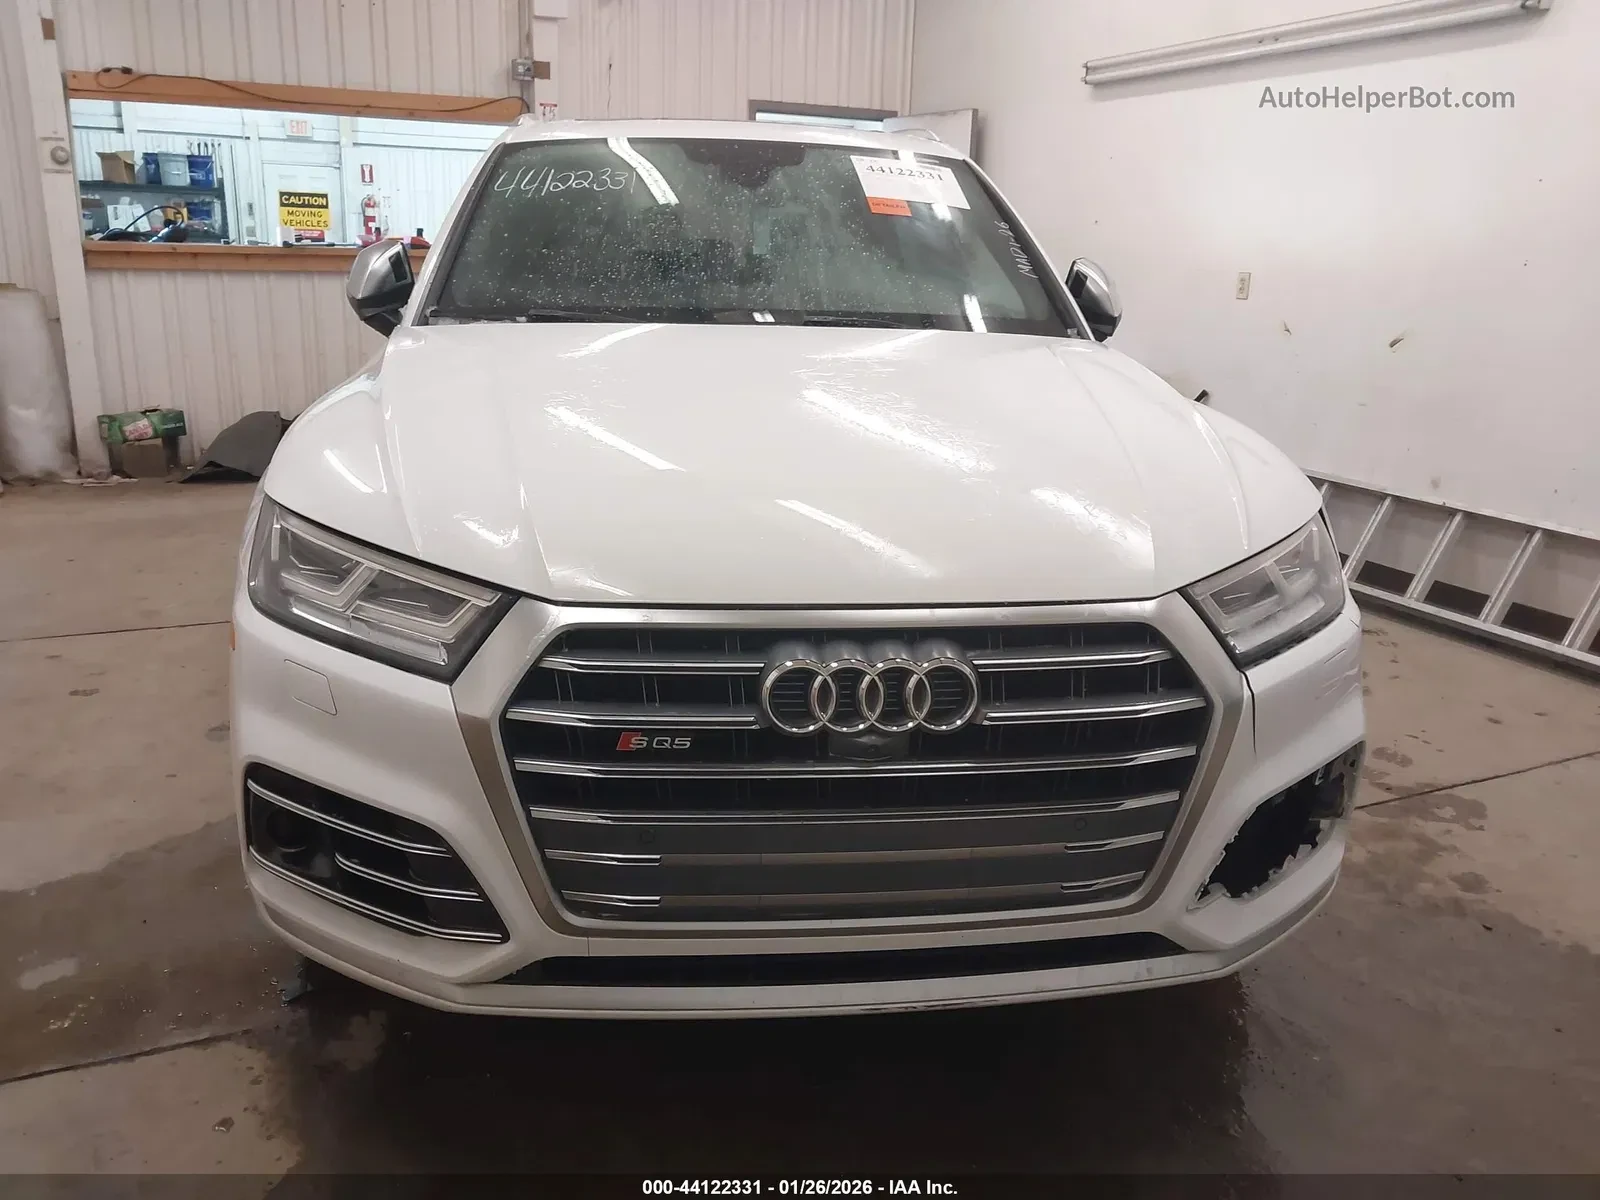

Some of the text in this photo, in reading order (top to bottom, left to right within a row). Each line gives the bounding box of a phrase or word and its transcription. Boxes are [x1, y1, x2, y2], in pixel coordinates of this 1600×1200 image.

[288, 119, 308, 135] EXIT
[866, 165, 944, 181] 44122331
[493, 166, 636, 198] 44122331
[281, 195, 327, 206] CAUTION
[287, 209, 323, 218] MOVING
[282, 219, 329, 228] VEHICLES
[628, 736, 692, 749] SQ5
